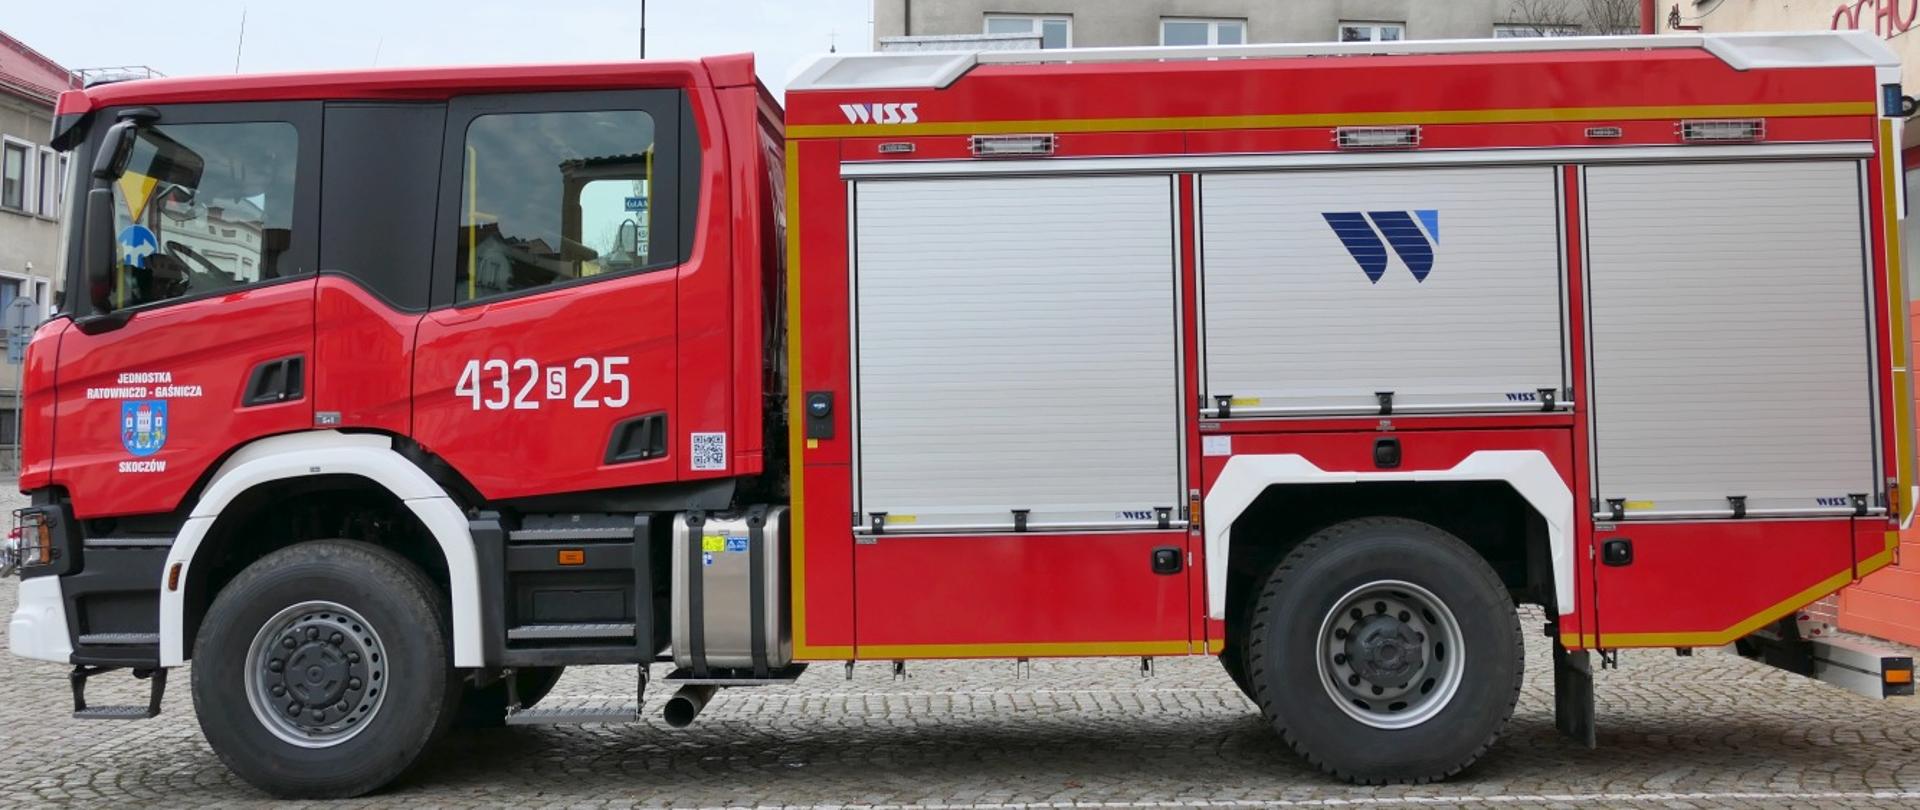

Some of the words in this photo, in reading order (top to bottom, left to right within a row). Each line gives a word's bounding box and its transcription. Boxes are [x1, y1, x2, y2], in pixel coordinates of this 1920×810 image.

[839, 103, 918, 124] WISS
[117, 372, 172, 384] JEDNOSTKA
[455, 359, 540, 410] 432
[549, 369, 564, 397] S
[573, 356, 629, 408] 25
[87, 387, 147, 399] RATOWNICZO
[155, 384, 202, 398] GAŚNICZA
[1505, 392, 1536, 401] WISS
[119, 459, 166, 472] SKOCZÓW
[1816, 497, 1846, 506] WISS
[1122, 511, 1152, 520] WISS
